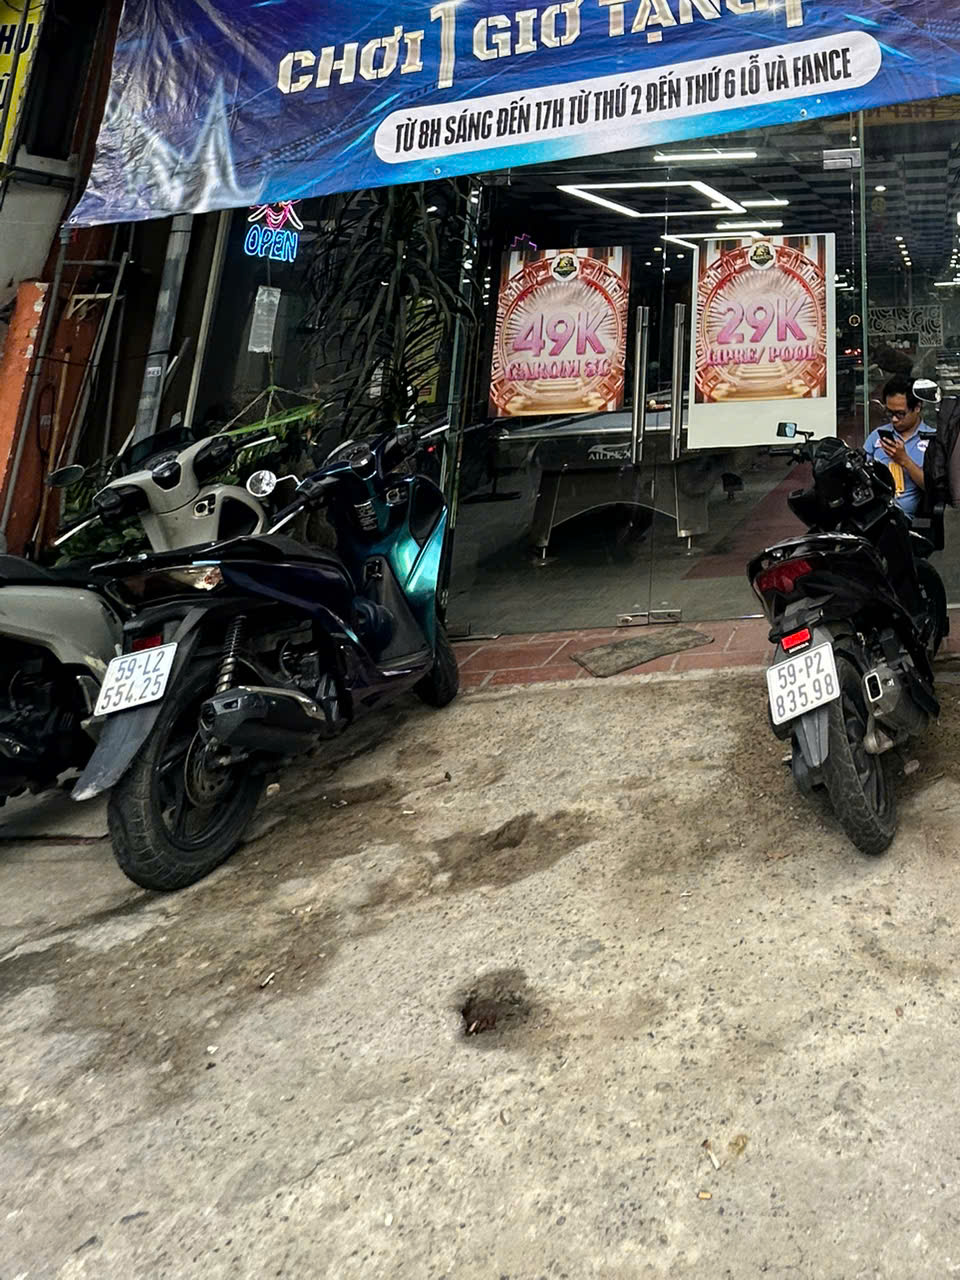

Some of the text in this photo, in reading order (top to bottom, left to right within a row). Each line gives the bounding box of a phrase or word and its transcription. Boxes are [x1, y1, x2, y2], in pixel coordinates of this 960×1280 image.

[277, 26, 425, 95] CHƠI
[430, 0, 458, 89] 1
[395, 48, 852, 154] TỪ 8H SÁNG ĐẾN 17H TỪ THỨ 2 ĐẾN THỨ 6 LỖ VÀ FANCE
[244, 224, 298, 263] OPEN
[511, 310, 609, 357] 49K
[716, 296, 810, 345] 29K
[115, 650, 165, 683] 59-L2
[777, 651, 825, 690] 59-P2
[101, 673, 164, 710] 554.25
[775, 673, 834, 718] 835.98
